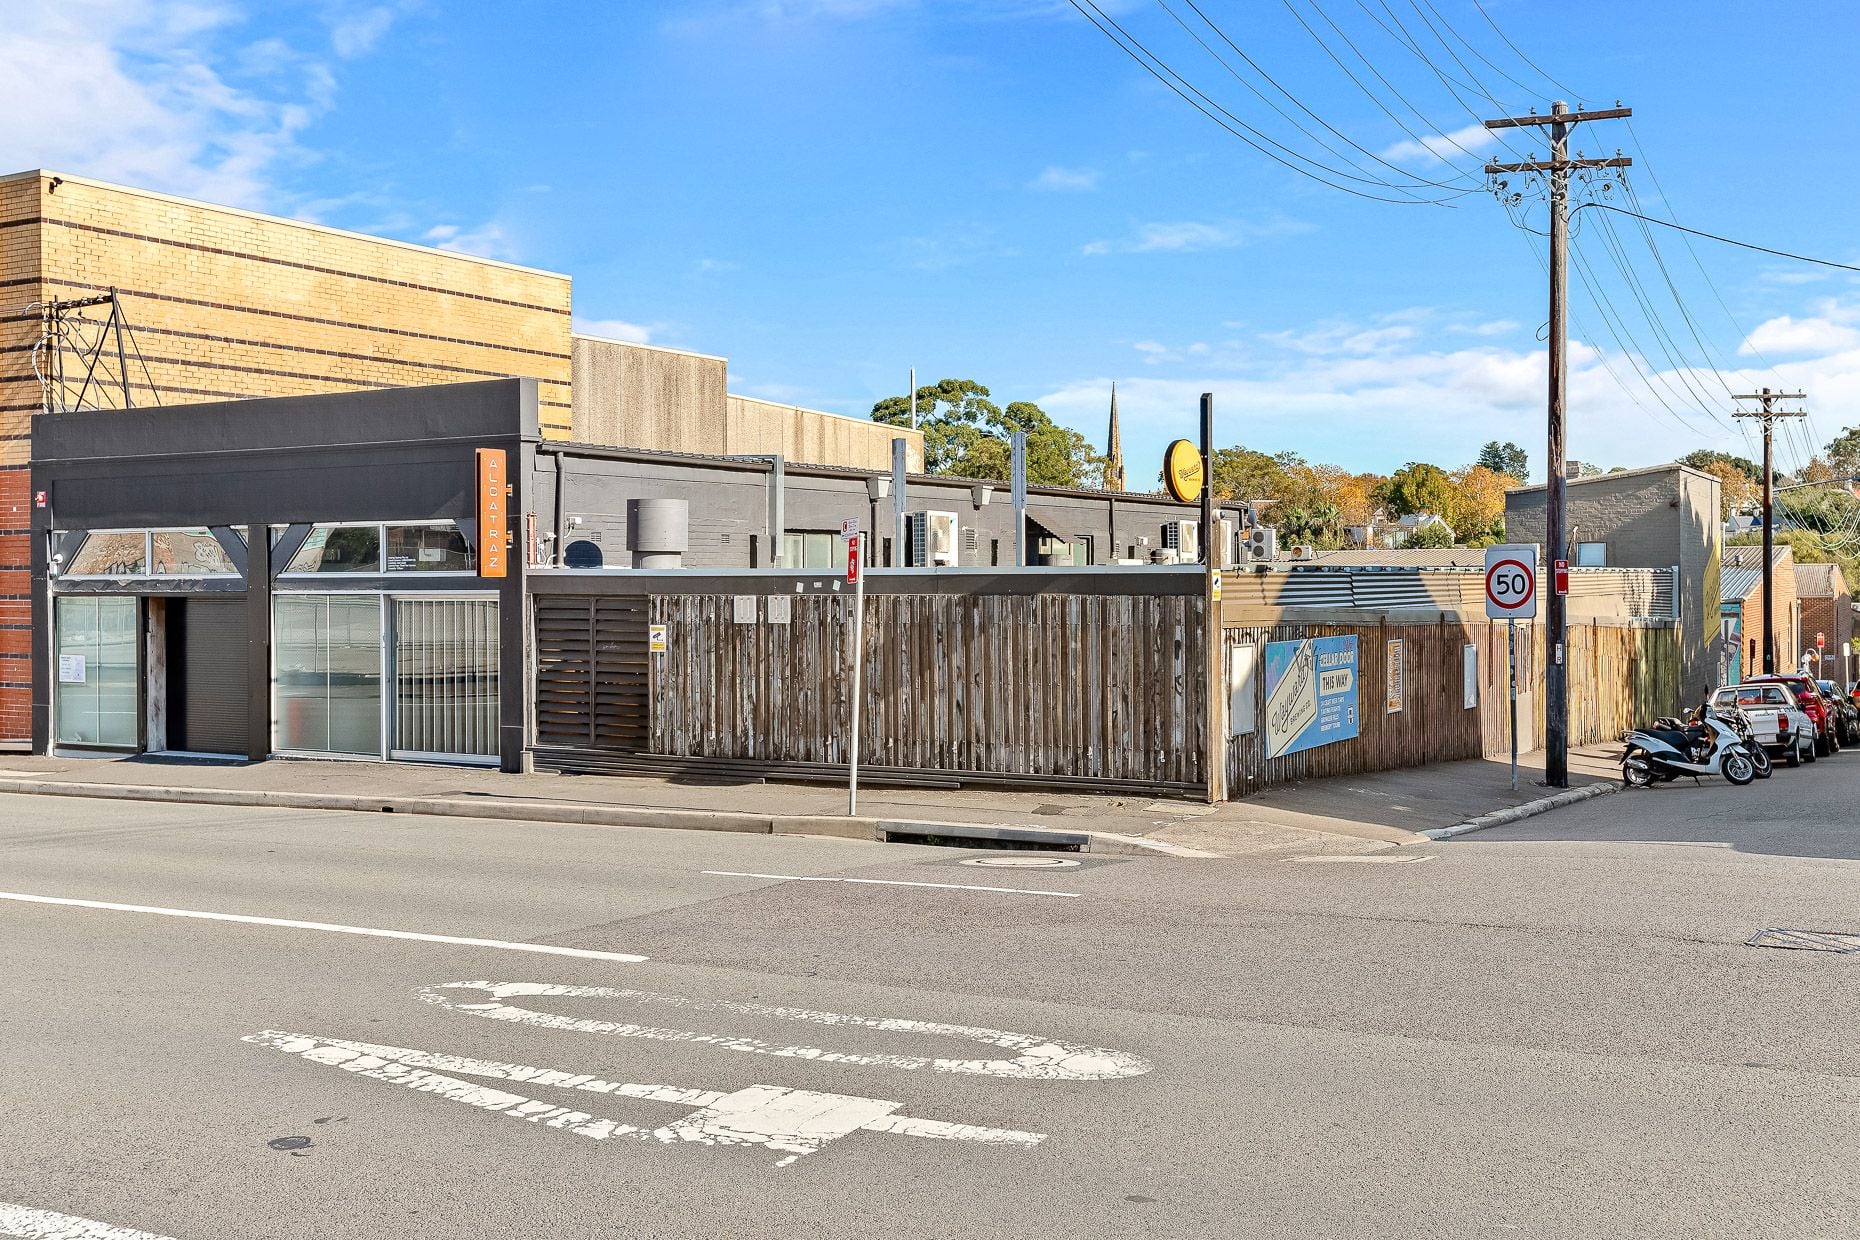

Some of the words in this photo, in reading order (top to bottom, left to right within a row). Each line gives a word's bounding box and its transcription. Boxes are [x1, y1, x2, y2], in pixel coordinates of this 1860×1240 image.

[489, 459, 498, 567] ALCATRAZ
[1496, 573, 1526, 595] 50
[1322, 675, 1334, 690] THIS
[1336, 673, 1348, 688] WAY
